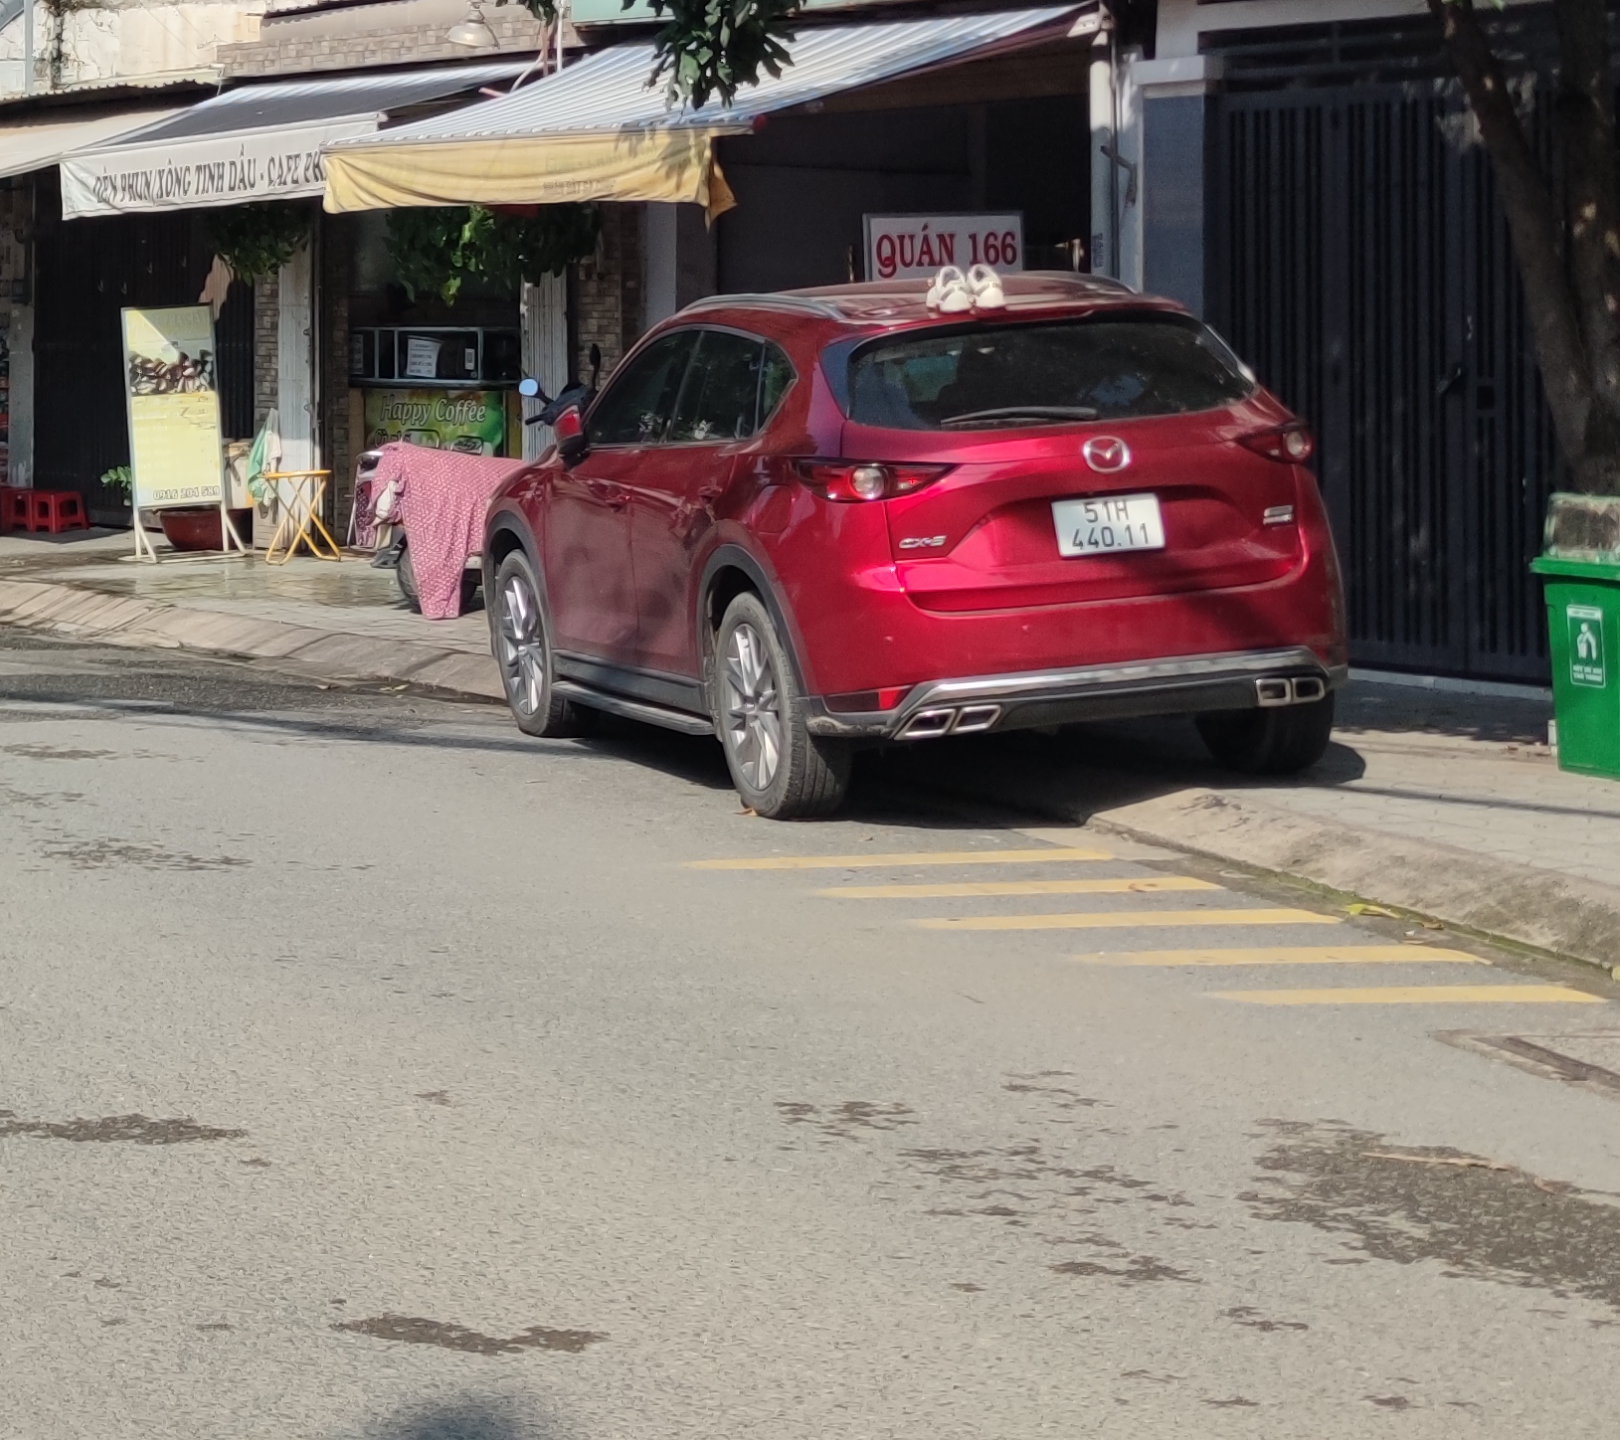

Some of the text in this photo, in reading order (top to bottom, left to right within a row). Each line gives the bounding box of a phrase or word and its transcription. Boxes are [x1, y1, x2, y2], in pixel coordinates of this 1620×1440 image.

[194, 160, 226, 196] TINH
[876, 223, 1018, 278] QUÁN 166
[381, 395, 486, 426] Happy Coffee
[1083, 499, 1130, 523] 51H
[899, 535, 947, 549] CX-5
[1071, 523, 1151, 551] 440.11
